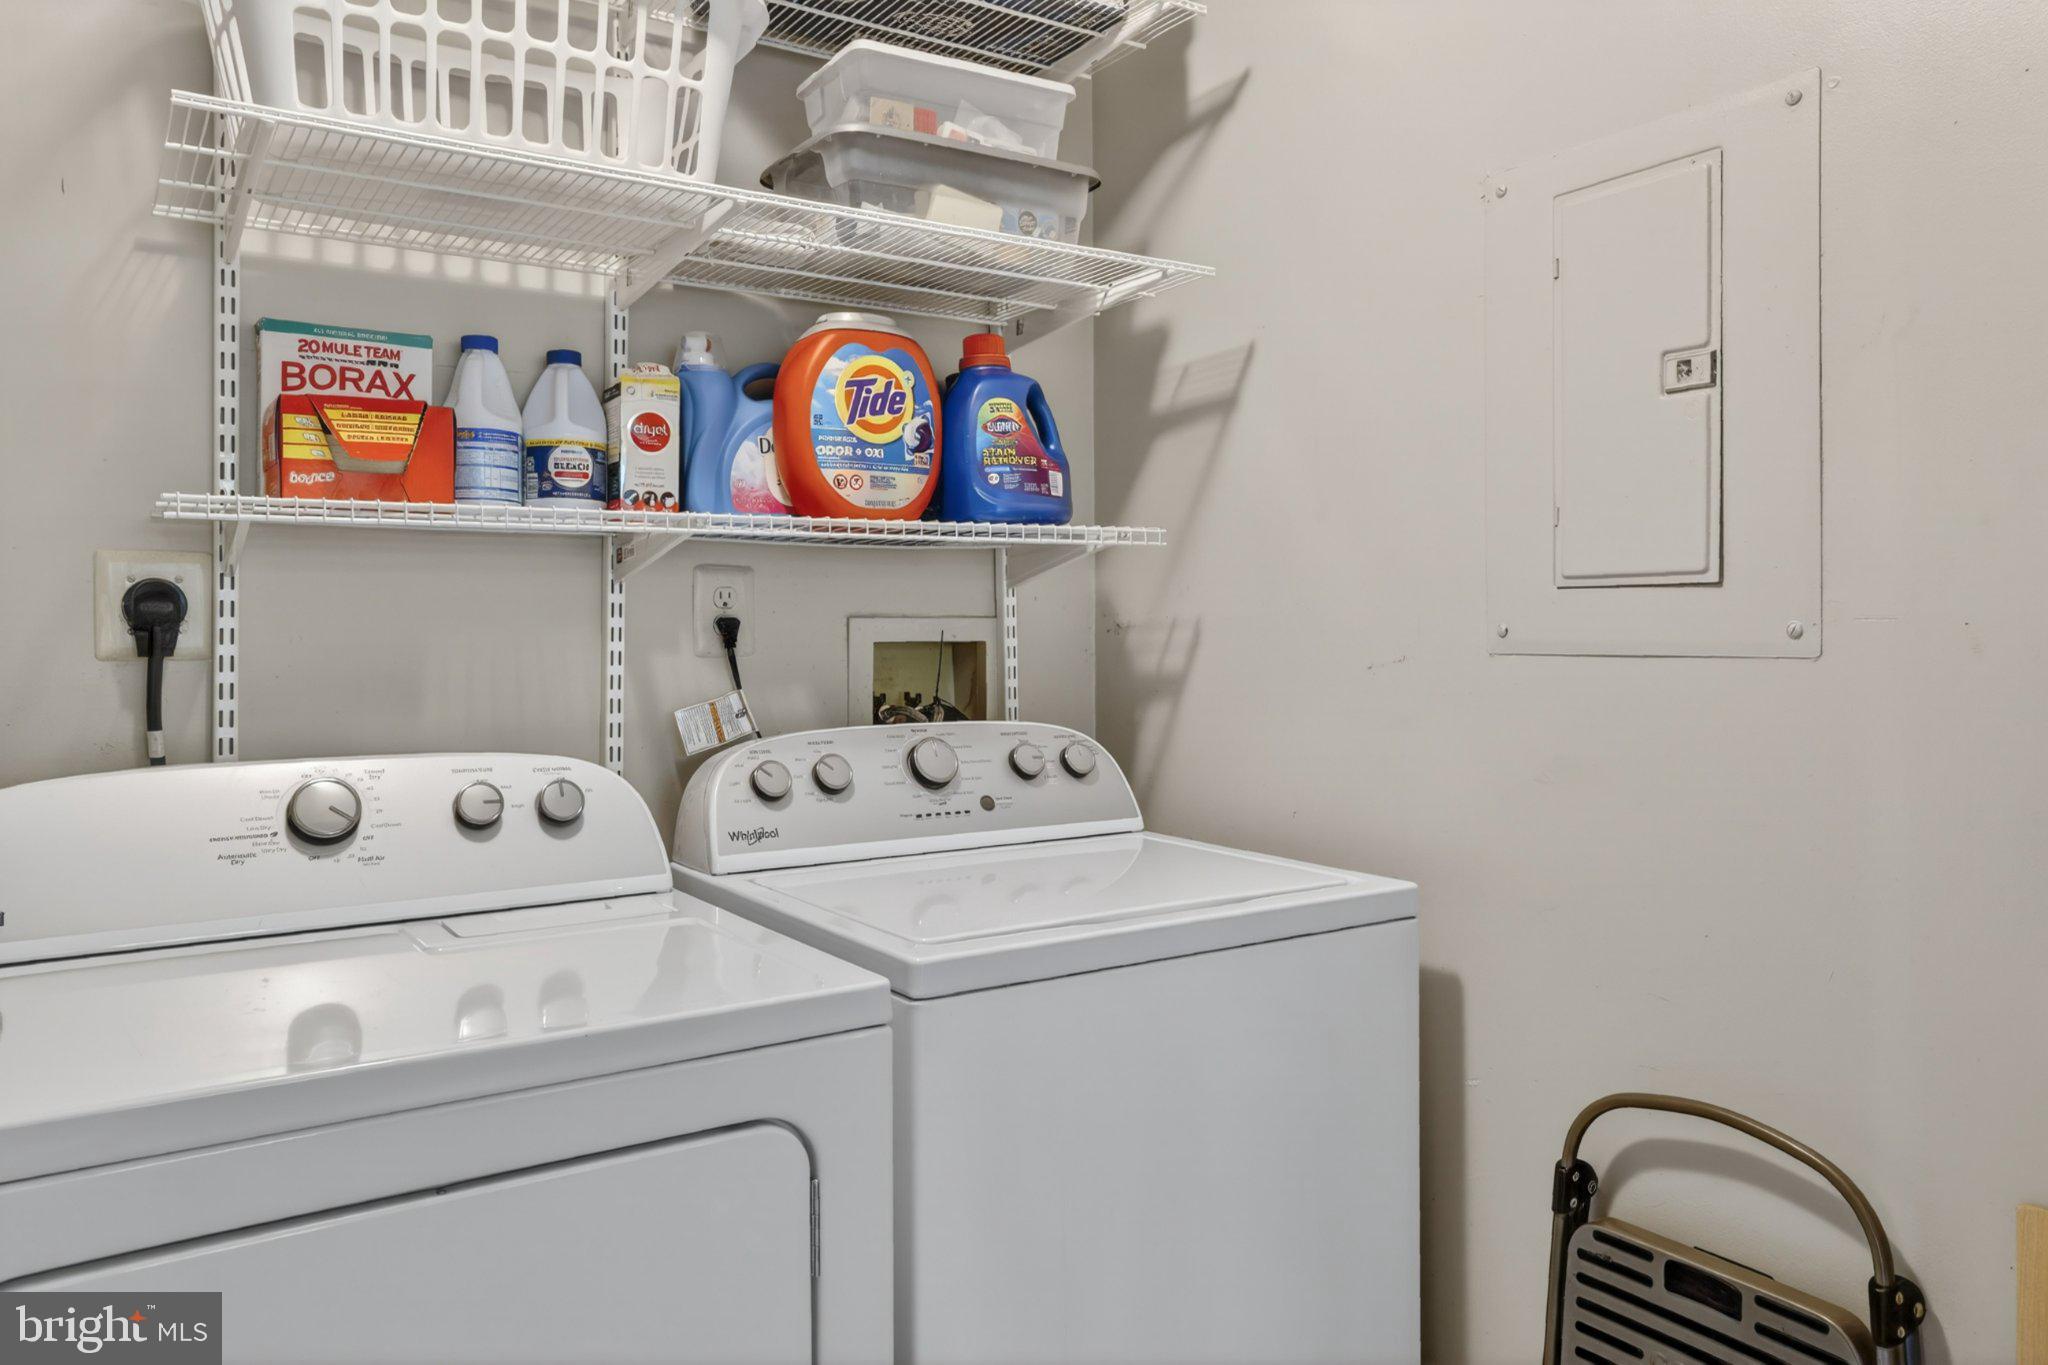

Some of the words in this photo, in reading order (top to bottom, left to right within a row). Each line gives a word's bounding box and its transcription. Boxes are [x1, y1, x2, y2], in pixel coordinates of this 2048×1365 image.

[297, 338, 321, 353] 20
[322, 341, 362, 358] MULE
[364, 346, 401, 361] TEAM
[280, 361, 416, 400] BORAX
[844, 378, 907, 426] Tide
[864, 447, 884, 458] OXI
[983, 456, 1038, 465] REMOVER
[728, 828, 780, 845] Whirlpool
